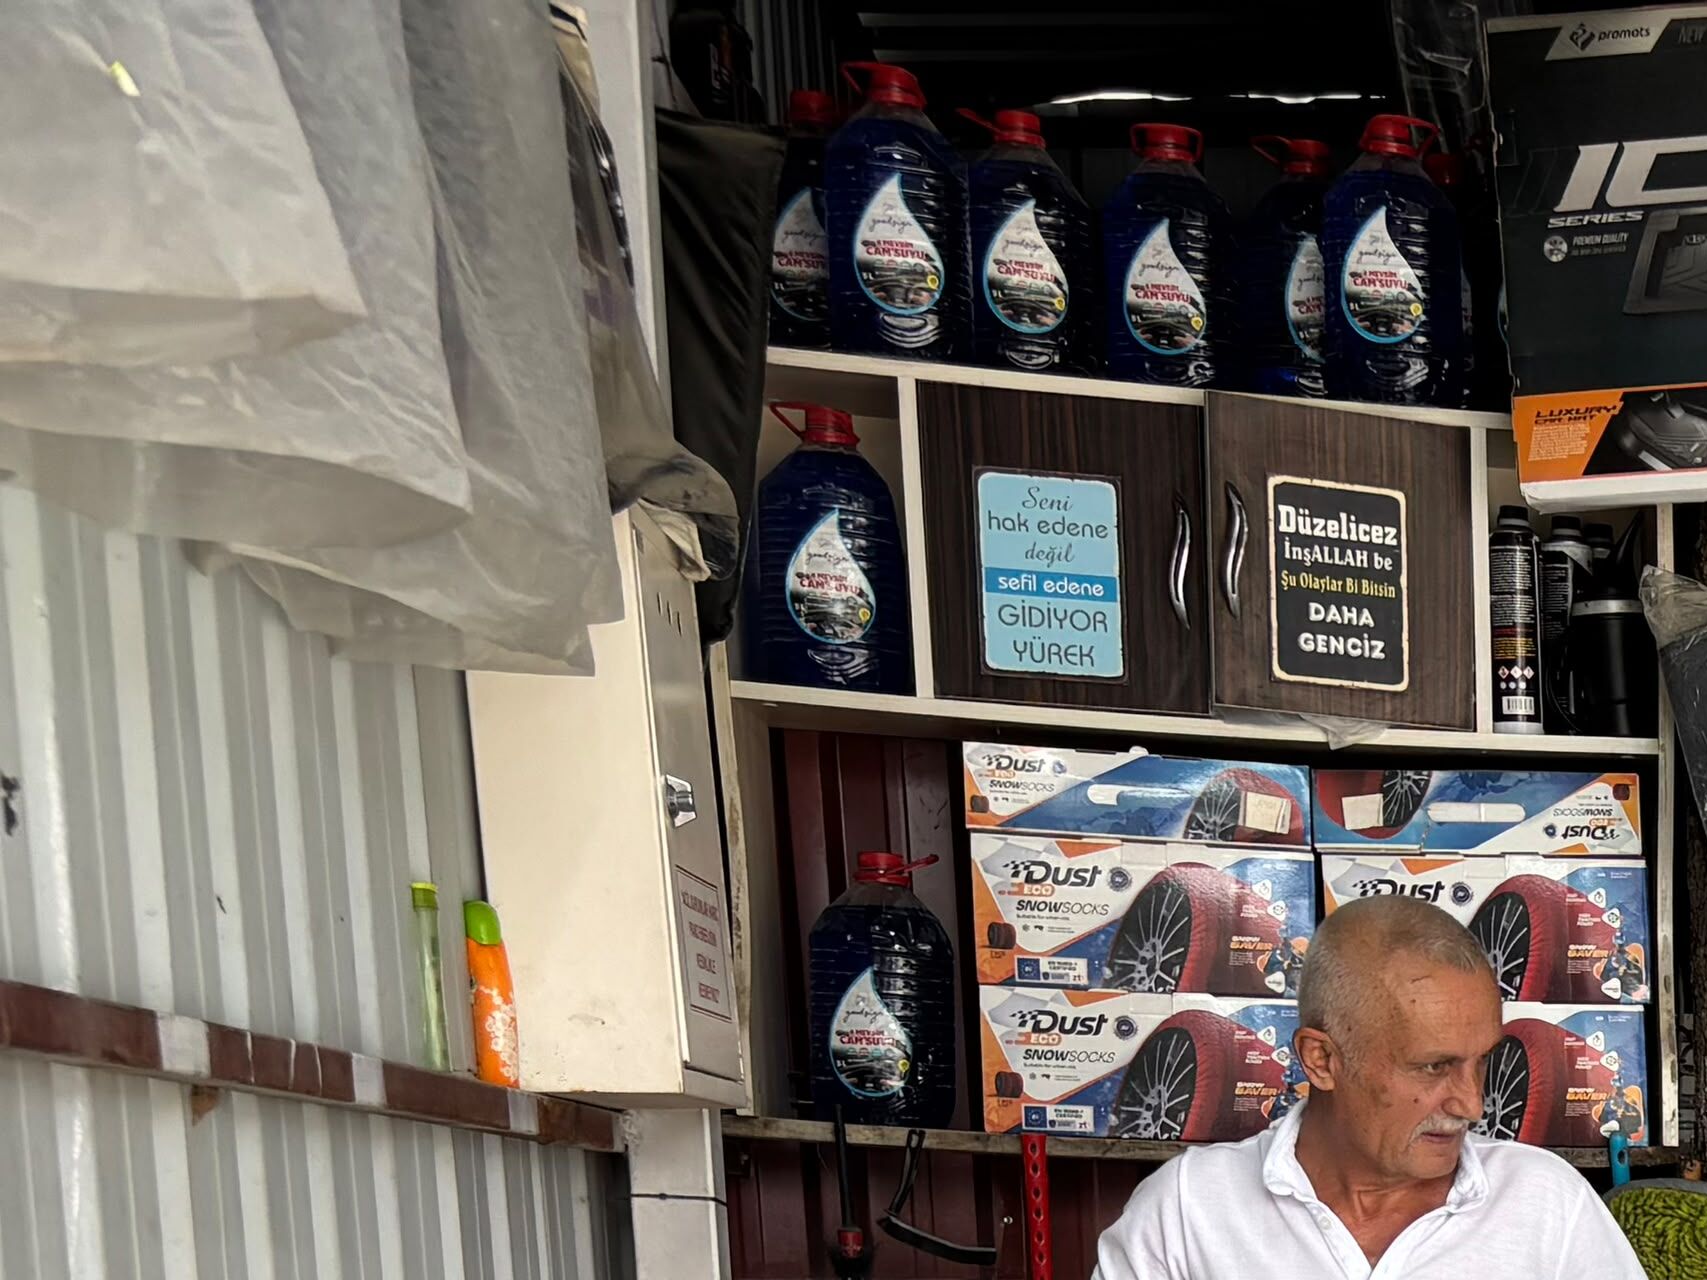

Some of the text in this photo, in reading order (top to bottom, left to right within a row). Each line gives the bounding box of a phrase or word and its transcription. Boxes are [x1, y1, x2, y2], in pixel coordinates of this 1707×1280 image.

[1547, 210, 1645, 229] SERIES
[1535, 404, 1618, 419] LUXURY
[1022, 486, 1073, 512] Seni
[988, 510, 1109, 539] hak edene
[1277, 504, 1398, 546] Düzelicez
[1024, 541, 1075, 568] değil
[1284, 536, 1394, 571] İnşALLAH be
[998, 573, 1105, 597] sefil edene
[1281, 569, 1396, 599] Şu Olaylar Bi Bitsin
[998, 600, 1108, 633] GİDİYOR
[1308, 602, 1375, 628] DAHA
[1013, 635, 1095, 667] YÜREK
[1297, 632, 1386, 660] GENCİZ
[994, 754, 1047, 773] Dust
[989, 779, 1055, 793] SNOWSOCKS
[1562, 824, 1607, 842] Dust
[1022, 859, 1102, 888] Dust
[1016, 899, 1110, 916] SNOWSOCKS
[1031, 1009, 1109, 1036] Dust
[1023, 1048, 1116, 1065] SNOWSOCKS
